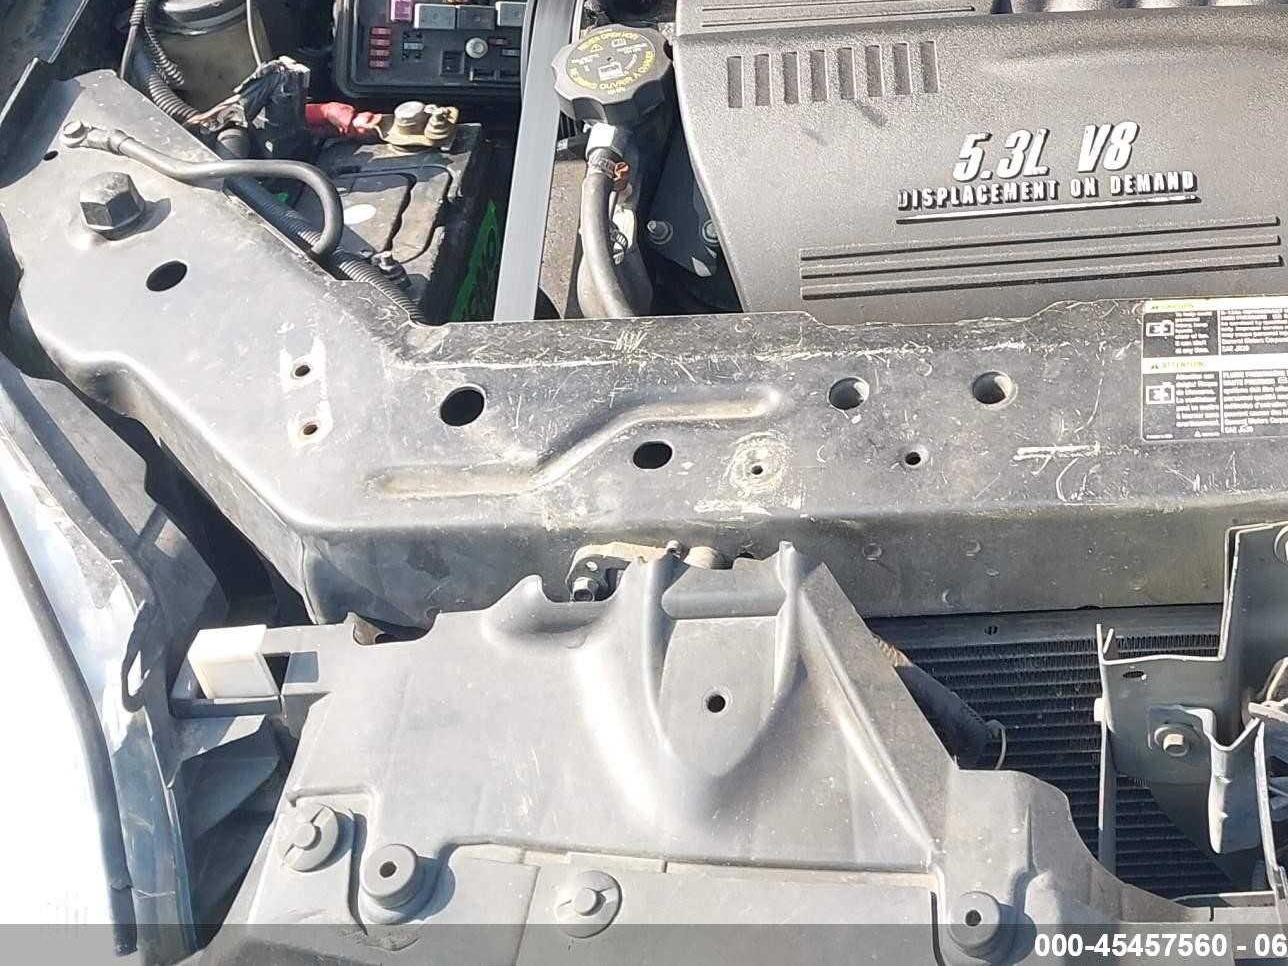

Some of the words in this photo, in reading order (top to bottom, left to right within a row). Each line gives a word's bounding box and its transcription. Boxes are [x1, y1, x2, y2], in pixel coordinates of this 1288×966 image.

[952, 128, 1050, 183] 5.3L
[1077, 121, 1139, 174] V8
[897, 180, 1060, 211] DISPLACEMENT
[1071, 177, 1099, 198] ON
[1110, 170, 1198, 196] DEMAND
